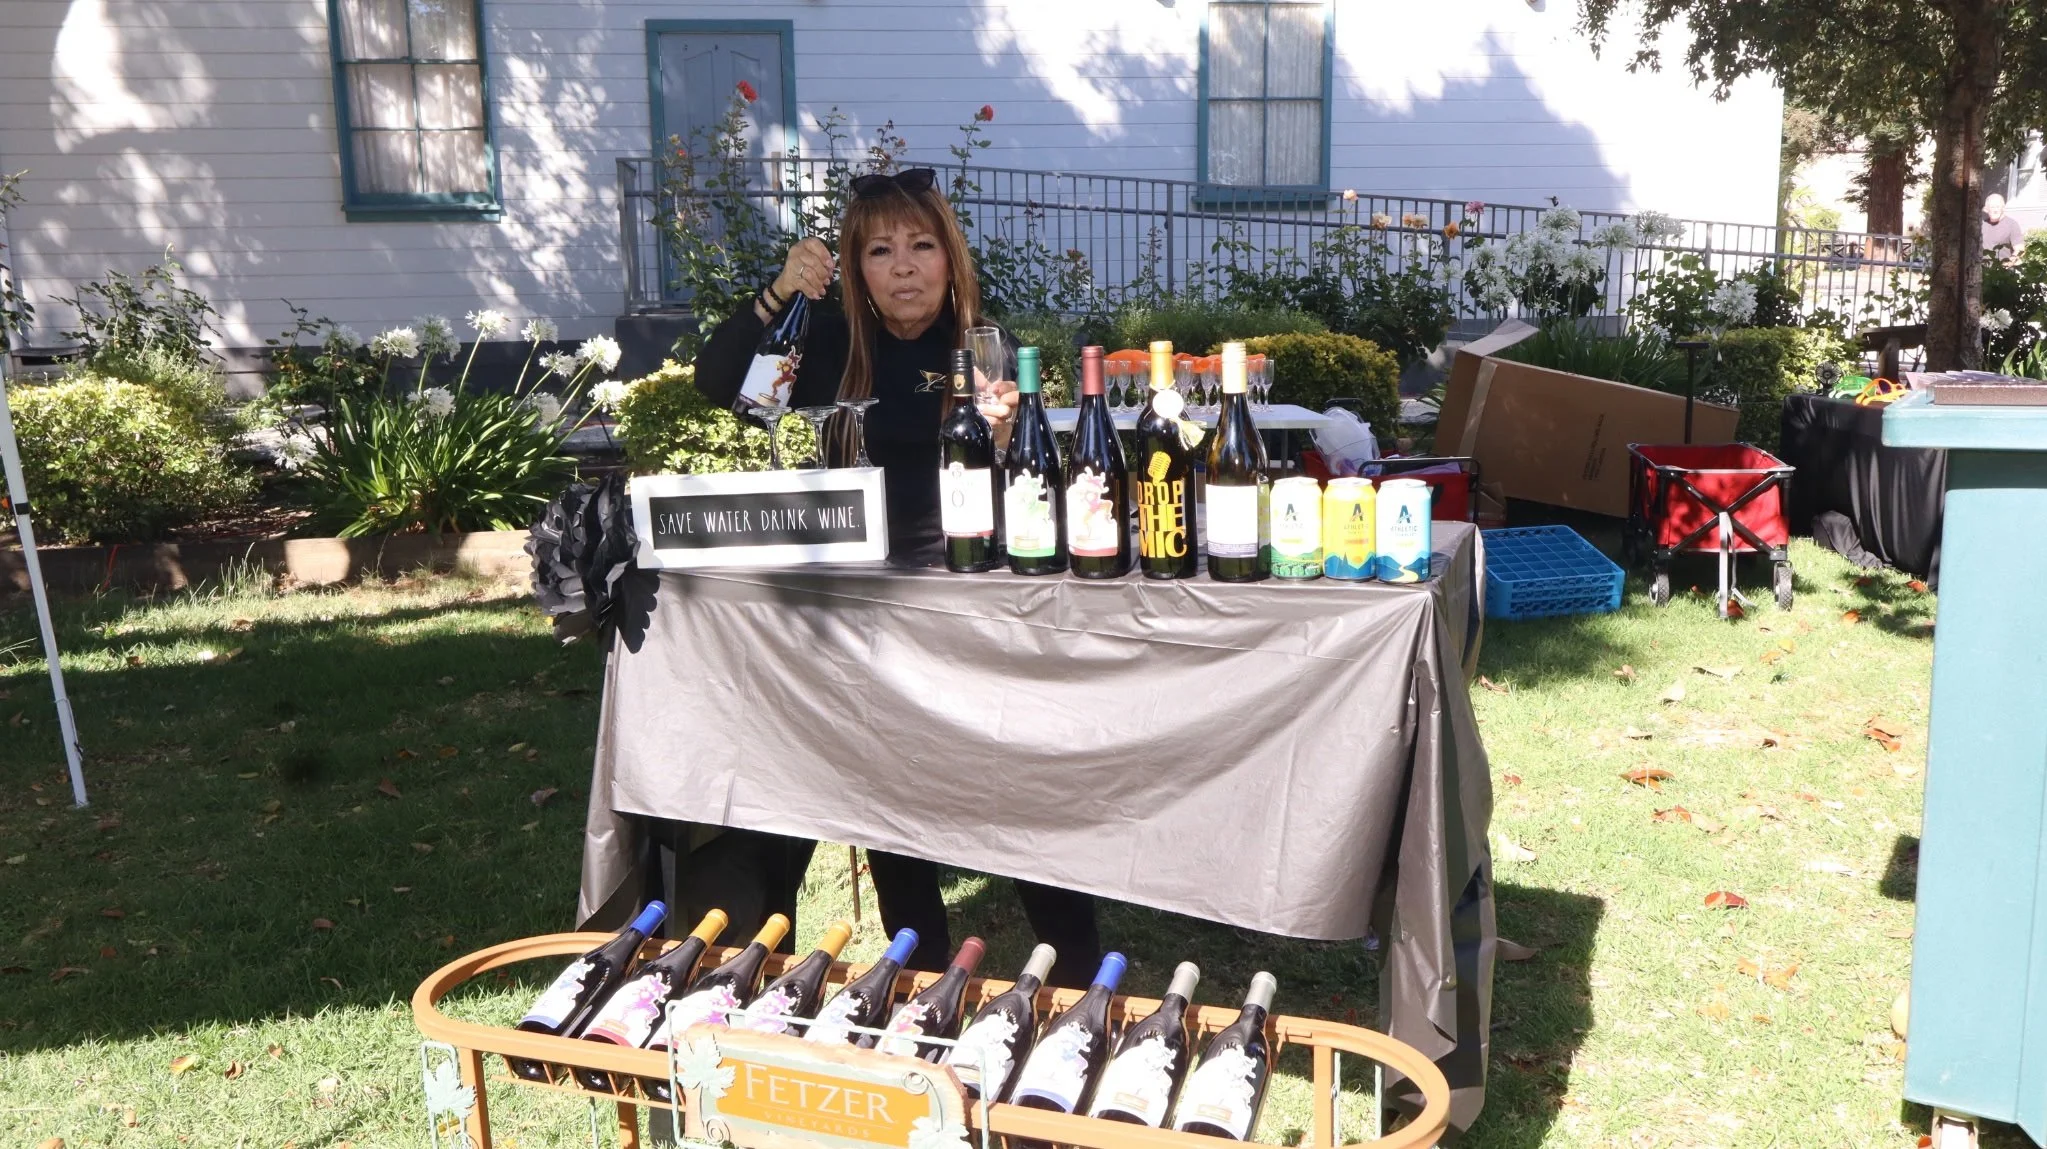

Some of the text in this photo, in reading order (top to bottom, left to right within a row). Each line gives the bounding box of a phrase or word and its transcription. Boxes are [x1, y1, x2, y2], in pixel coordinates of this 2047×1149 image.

[1137, 481, 1184, 505] DROP
[659, 506, 860, 535] SAVE WATER DRINK WINE.
[1138, 503, 1186, 532] THE
[1139, 529, 1188, 558] MIC
[745, 1063, 894, 1124] FETZER
[765, 1111, 871, 1138] VINEYARDS
